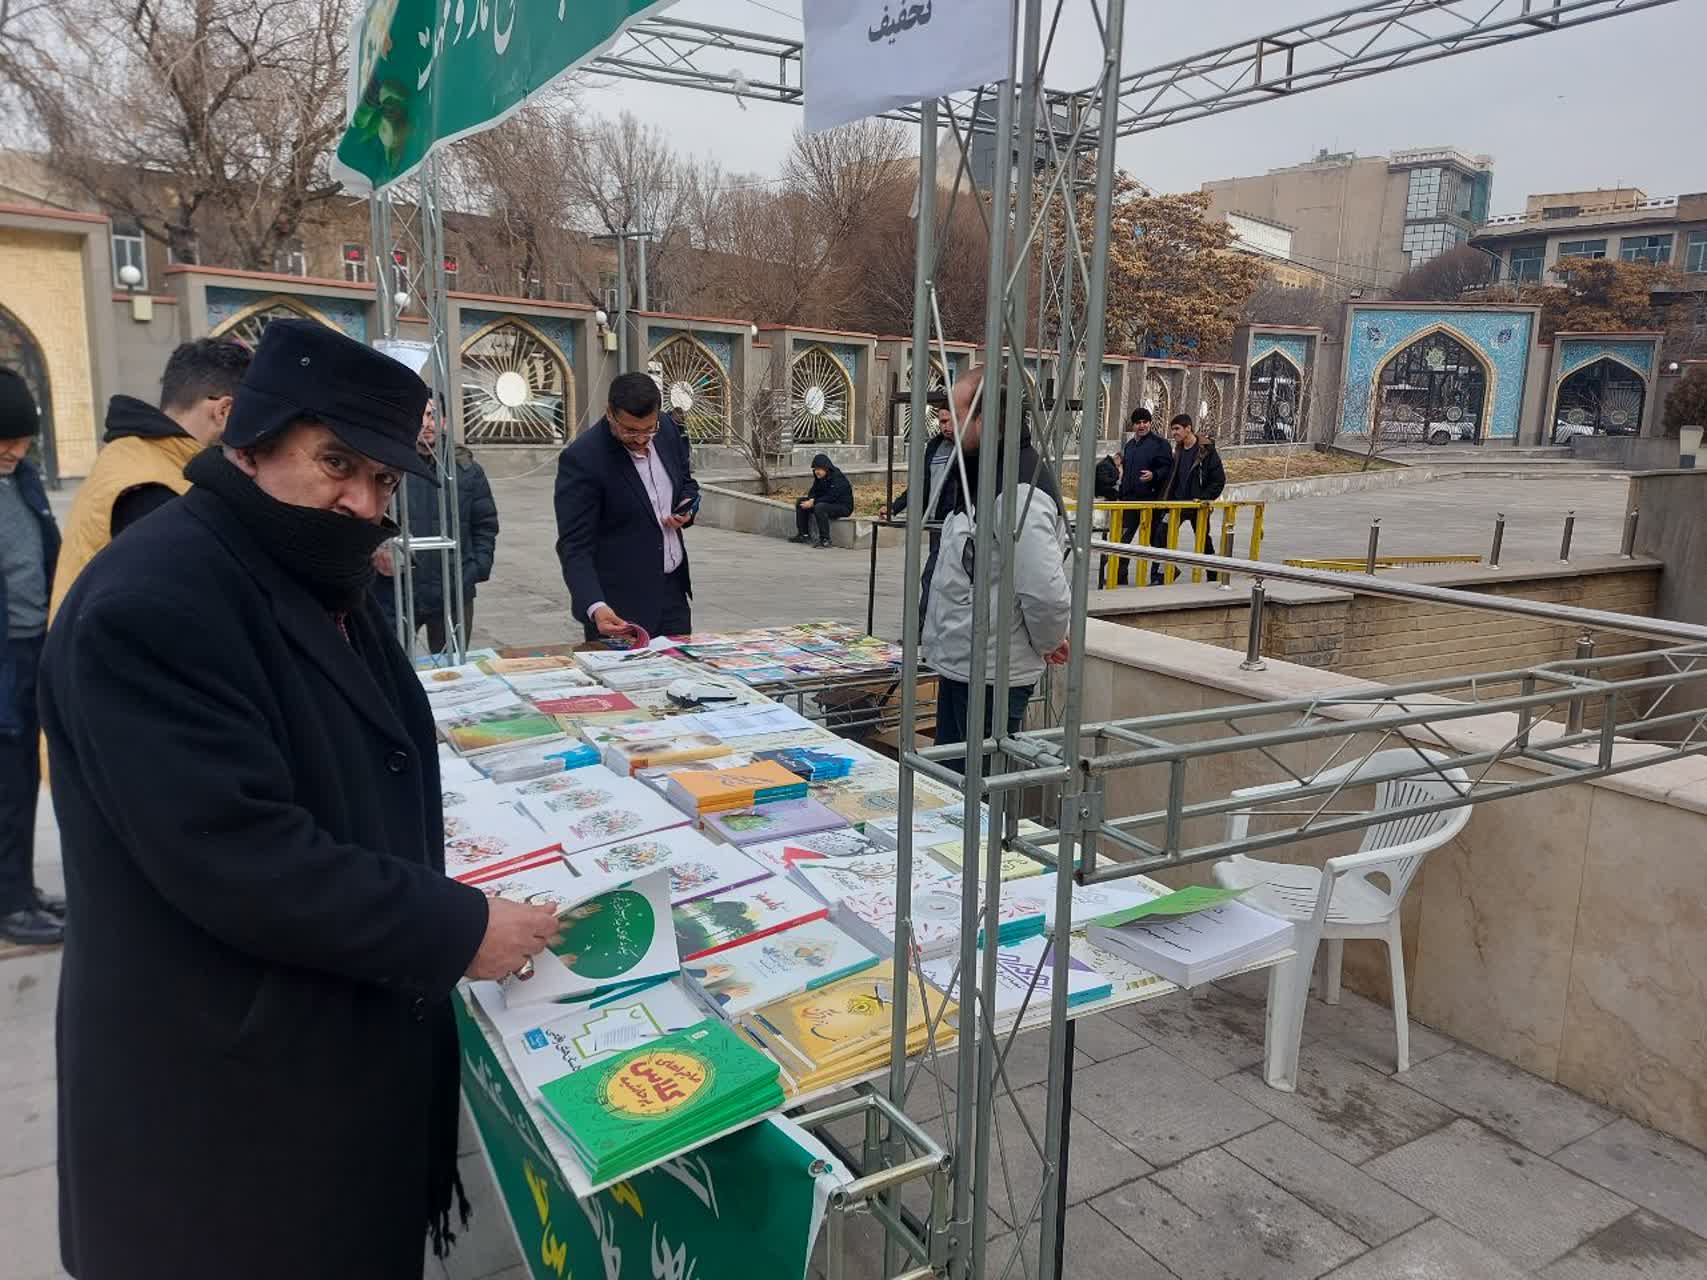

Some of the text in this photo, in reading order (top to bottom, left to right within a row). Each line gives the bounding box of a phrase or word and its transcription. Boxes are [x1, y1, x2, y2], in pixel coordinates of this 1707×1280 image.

[630, 1061, 686, 1102] کلاس
[655, 1059, 702, 1083] ماجراهای
[620, 1076, 654, 1107] پرحاشیه
